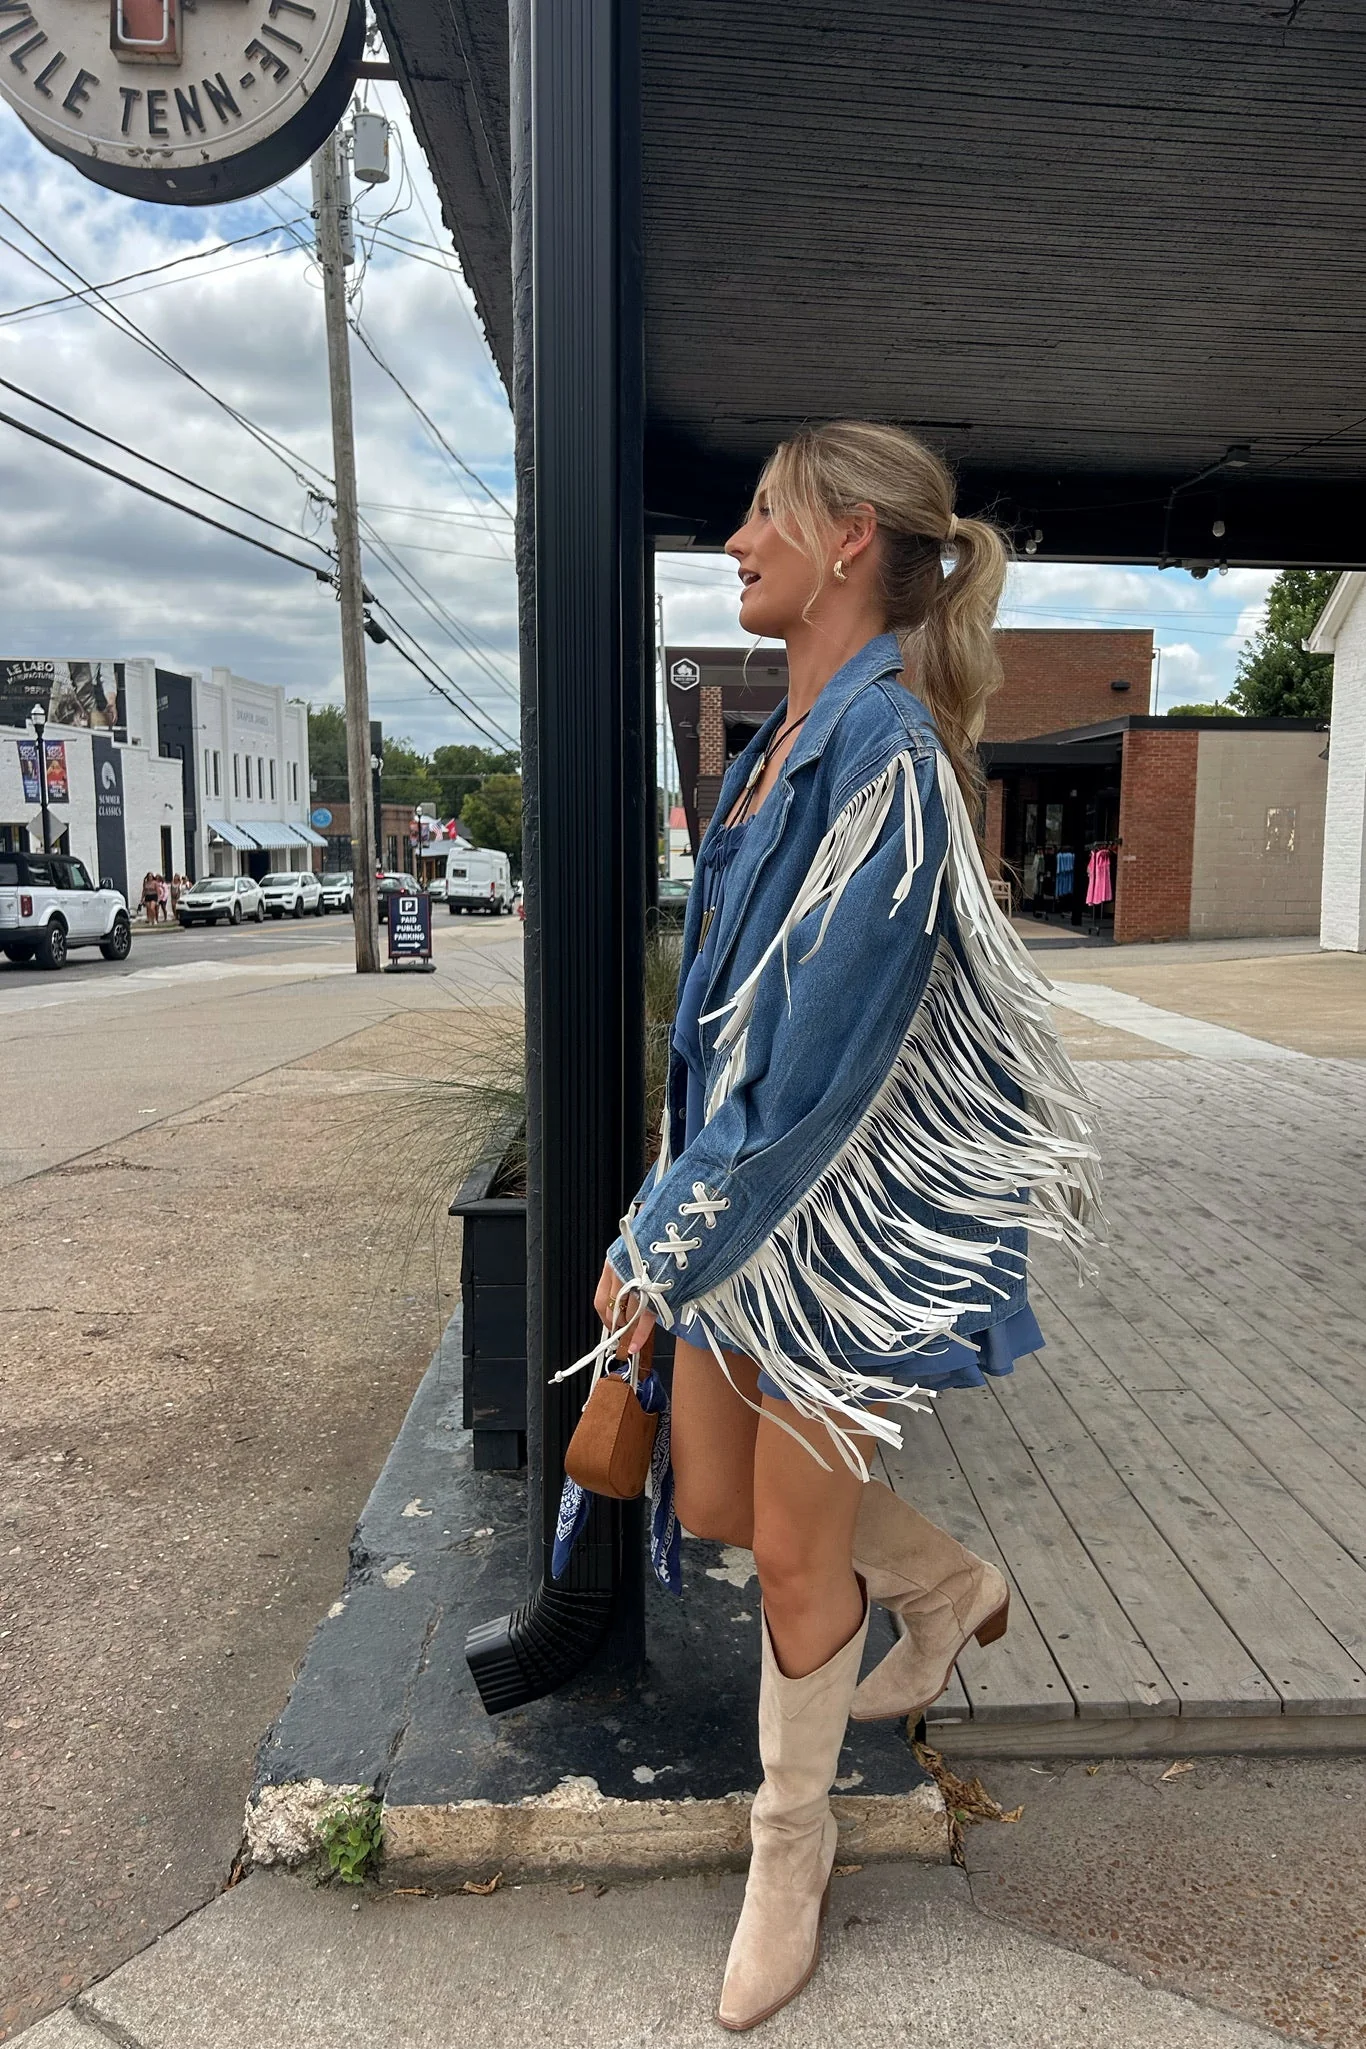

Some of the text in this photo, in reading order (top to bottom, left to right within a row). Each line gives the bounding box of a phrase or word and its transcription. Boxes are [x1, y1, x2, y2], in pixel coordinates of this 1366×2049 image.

[6, 663, 22, 676] LE
[405, 901, 413, 911] P
[394, 932, 425, 941] PARKING
